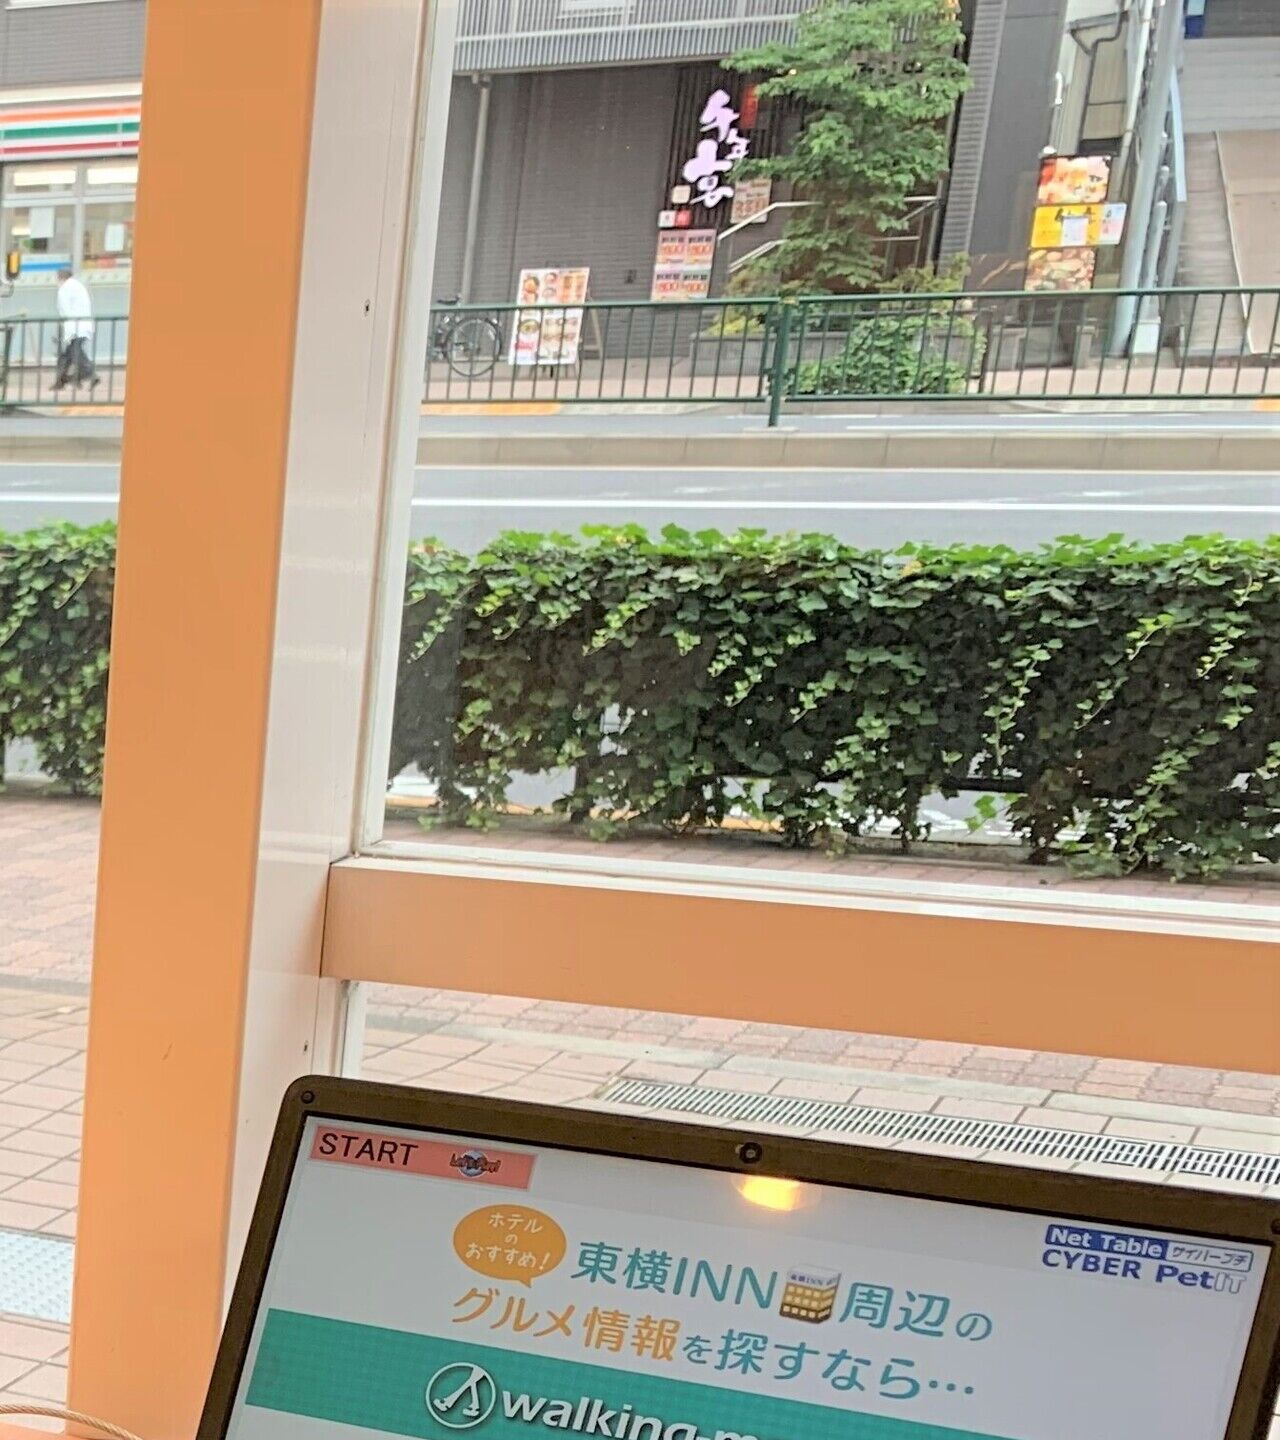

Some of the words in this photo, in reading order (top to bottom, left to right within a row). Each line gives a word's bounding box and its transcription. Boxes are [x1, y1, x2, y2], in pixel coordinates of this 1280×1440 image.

[318, 1131, 419, 1168] START
[488, 1212, 543, 1235] ホテル
[505, 1233, 519, 1246] の
[1049, 1227, 1092, 1249] Net
[1100, 1234, 1163, 1258] Table
[1042, 1248, 1142, 1280] CYBER
[570, 1240, 780, 1310] 東横INN
[838, 1281, 994, 1343] 周辺の
